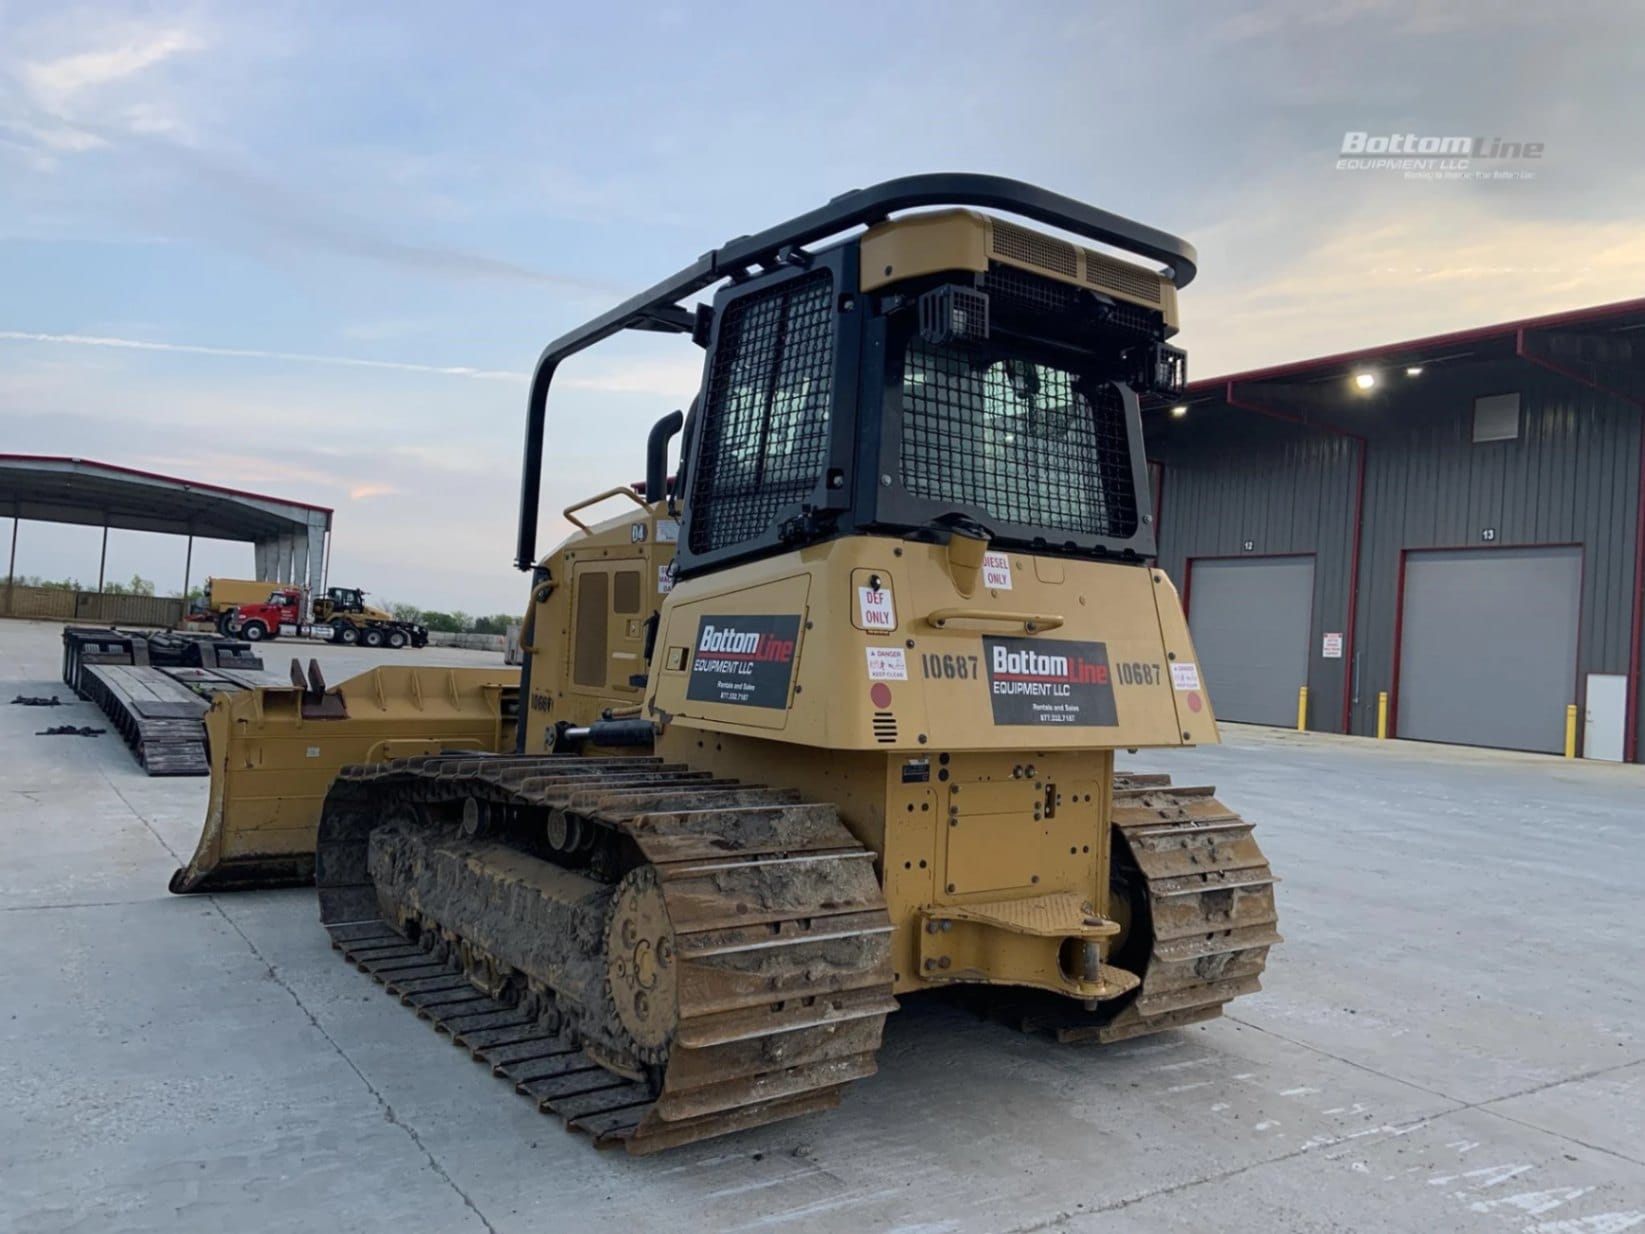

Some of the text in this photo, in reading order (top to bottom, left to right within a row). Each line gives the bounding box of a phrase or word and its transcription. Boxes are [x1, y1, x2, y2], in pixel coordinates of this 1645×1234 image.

[1483, 529, 1494, 540] 13
[984, 556, 1008, 569] DIESEL
[988, 573, 1008, 585] ONLY
[866, 591, 884, 604] DEF
[866, 610, 889, 624] ONLY
[694, 659, 754, 675] EQUIPMENT LLC
[922, 653, 978, 680] 10687
[1117, 662, 1160, 686] 10687
[993, 681, 1070, 697] EQUIPMENT LLC
